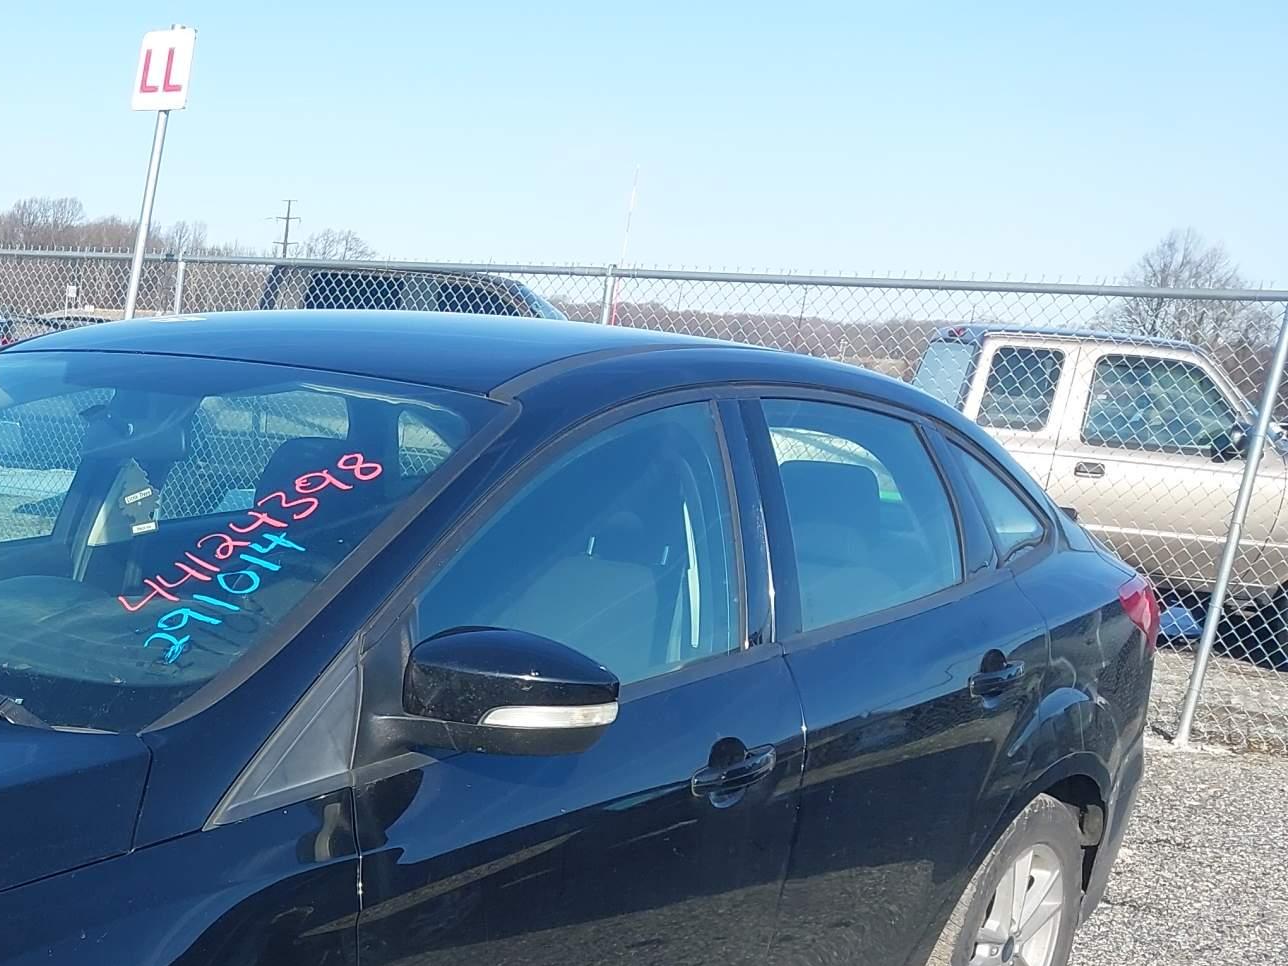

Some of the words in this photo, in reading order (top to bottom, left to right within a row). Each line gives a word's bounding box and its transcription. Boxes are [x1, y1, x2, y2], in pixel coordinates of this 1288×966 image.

[140, 47, 183, 93] LL
[118, 452, 383, 611] 44124398
[144, 532, 307, 664] 291014
